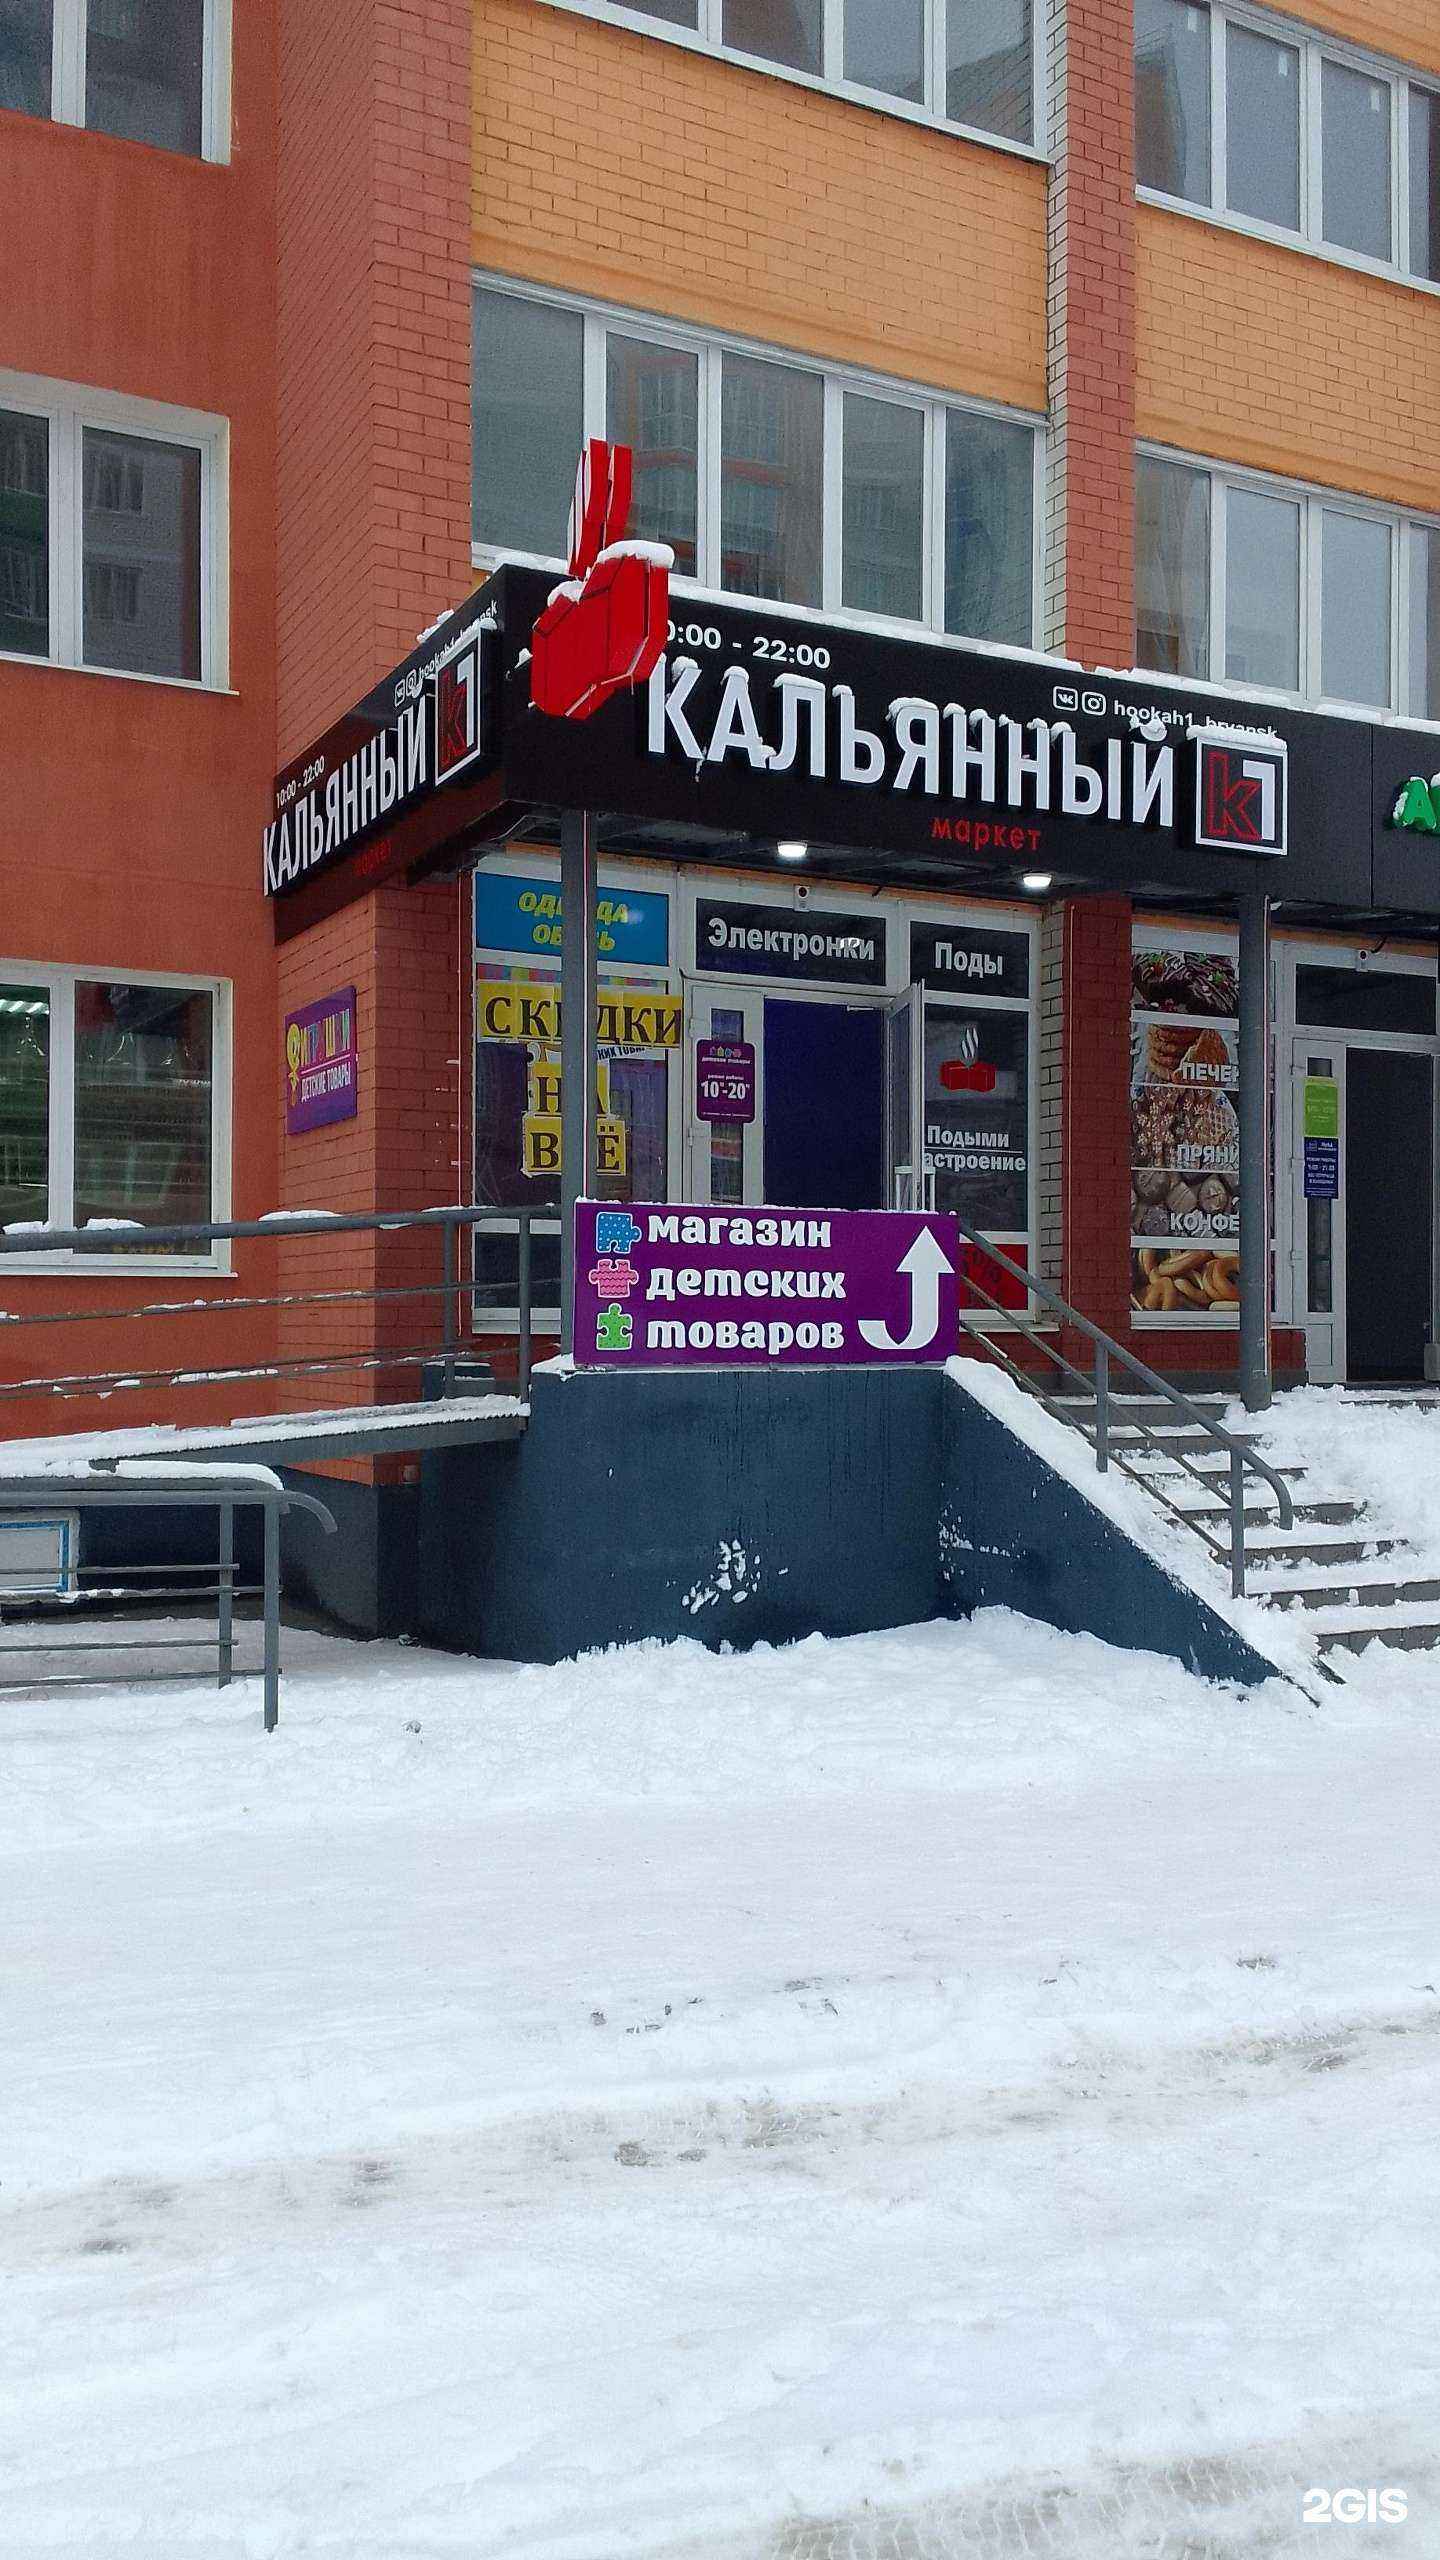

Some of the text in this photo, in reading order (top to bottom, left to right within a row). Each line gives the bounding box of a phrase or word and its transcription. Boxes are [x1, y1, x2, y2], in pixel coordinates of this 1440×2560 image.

[753, 637, 831, 669] 22:00
[649, 652, 1174, 828] КАЛЬЯННЫЙ
[264, 692, 427, 896] КАЛЬЯННЫЙ
[276, 780, 297, 808] 10:00
[303, 755, 325, 787] 22:00
[930, 815, 1042, 852] маркет
[518, 890, 629, 925] ОДДА
[532, 924, 616, 951] ОБЬ
[707, 917, 876, 962] Электронки
[934, 941, 1004, 978] Поды
[484, 996, 683, 1046] СКДКИ
[530, 1125, 620, 1171] ВЁ
[927, 1125, 1009, 1148] Подыми
[646, 1213, 832, 1249] магазин
[645, 1266, 847, 1300] детских
[646, 1319, 845, 1355] товаров
